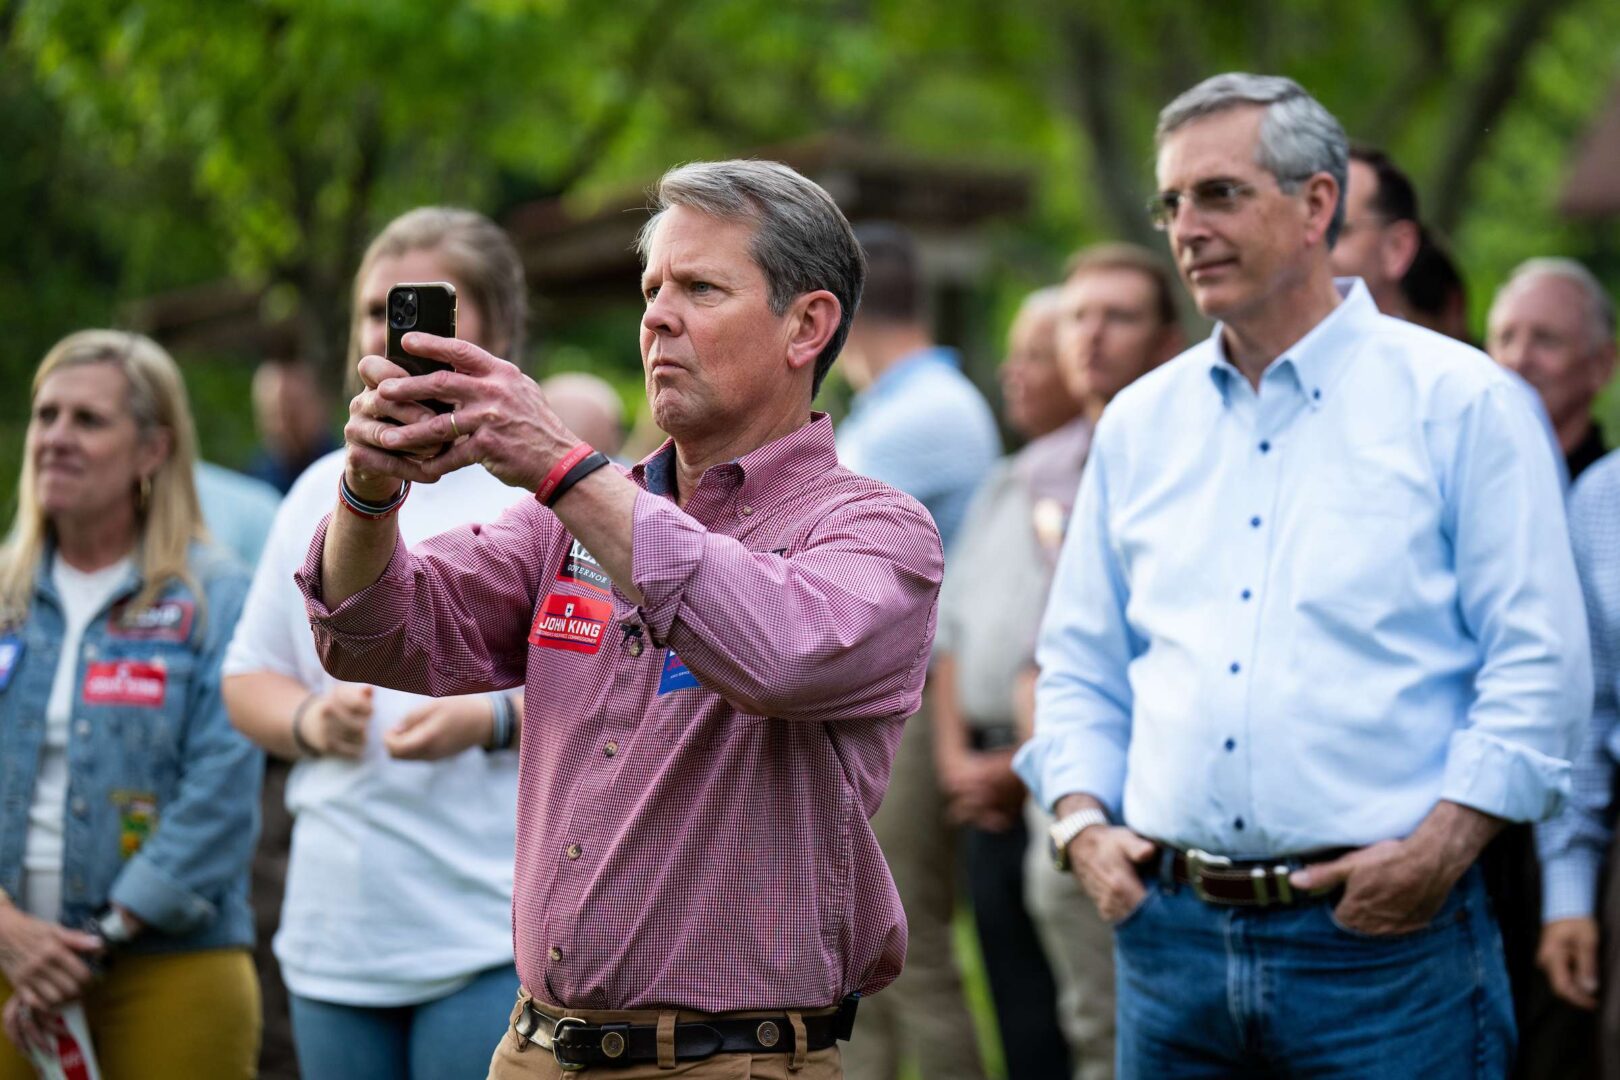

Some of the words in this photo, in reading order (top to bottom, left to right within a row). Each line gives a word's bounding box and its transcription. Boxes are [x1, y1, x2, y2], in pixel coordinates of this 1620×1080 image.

[567, 563, 607, 584] GOVERNOR
[539, 617, 566, 633] JOHN
[567, 620, 601, 638] KING
